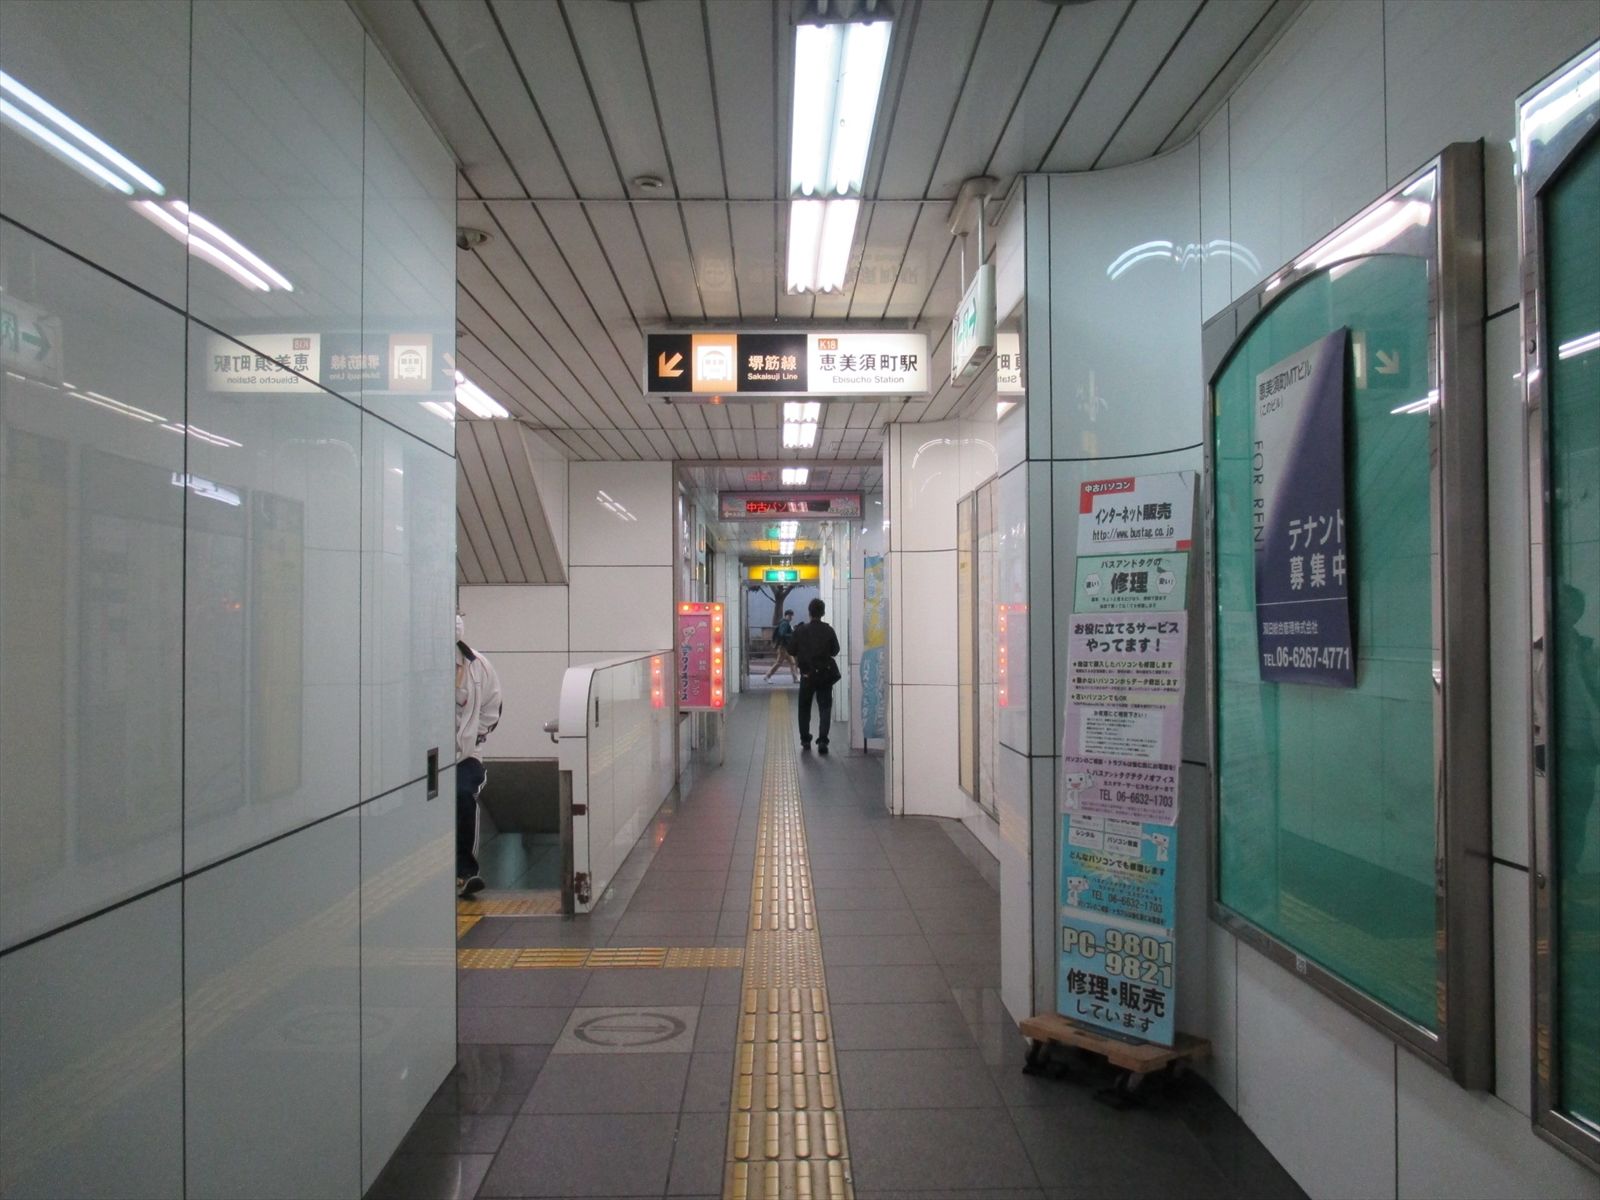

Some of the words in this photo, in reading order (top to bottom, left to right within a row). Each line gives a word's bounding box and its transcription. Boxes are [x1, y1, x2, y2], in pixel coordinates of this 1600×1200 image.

[819, 339, 836, 349] K18
[748, 354, 796, 371] 堺筋線
[819, 353, 918, 373] 恵美須町駅
[747, 372, 781, 381] Sakaisuji
[782, 372, 798, 380] Line
[832, 375, 872, 383] Ebisucho
[874, 375, 904, 383] Station
[1253, 440, 1264, 485] FOR
[1085, 482, 1130, 493] 中古パソコン
[1096, 502, 1172, 525] インターネット販売
[1289, 508, 1344, 551] テナント
[1101, 558, 1162, 569] バスアンドタグの
[1289, 549, 1346, 590] 募集中
[1111, 571, 1148, 594] 修理
[1074, 621, 1179, 635] お役に立てるサービス
[1086, 638, 1160, 652] やってます!
[1099, 788, 1112, 801] TEL
[1076, 829, 1095, 839] レンタル
[1091, 889, 1104, 901] TEL
[1062, 926, 1174, 965] PC-9801
[1105, 951, 1173, 988] 9821
[1067, 967, 1166, 1018] 修理・販売
[1076, 999, 1155, 1033] しています
